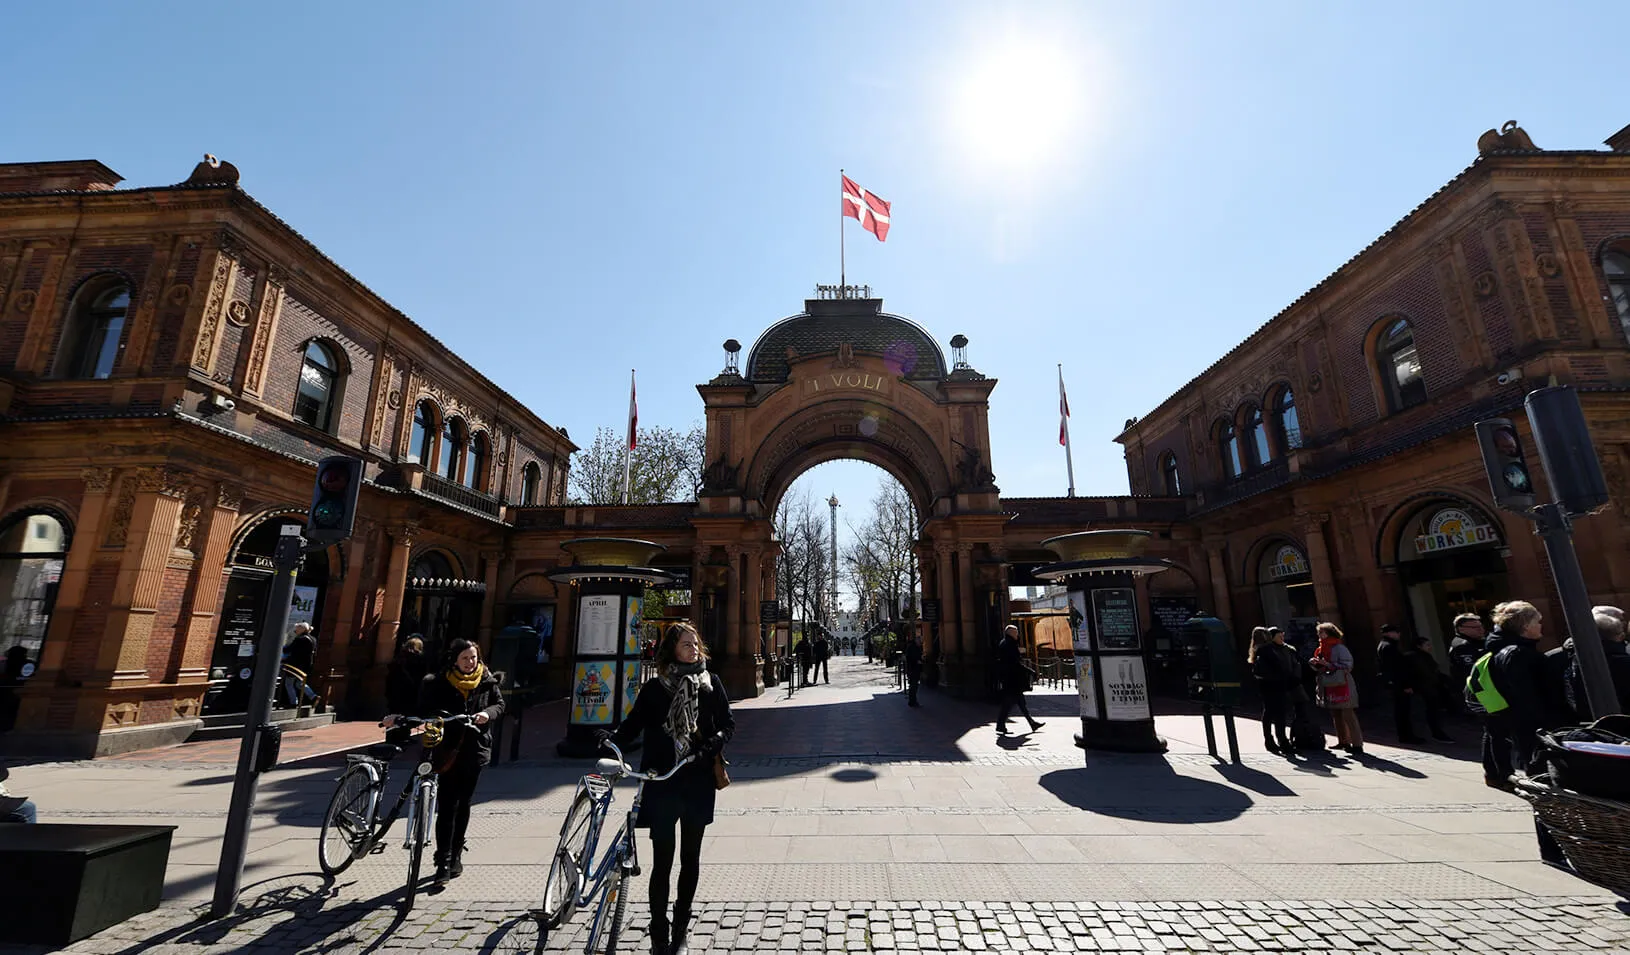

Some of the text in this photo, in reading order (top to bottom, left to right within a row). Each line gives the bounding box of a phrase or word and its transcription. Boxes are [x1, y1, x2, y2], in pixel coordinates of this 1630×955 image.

[808, 374, 882, 391] TVOLI
[1416, 526, 1497, 551] WORKSHOP
[1270, 560, 1308, 577] WORKSHO
